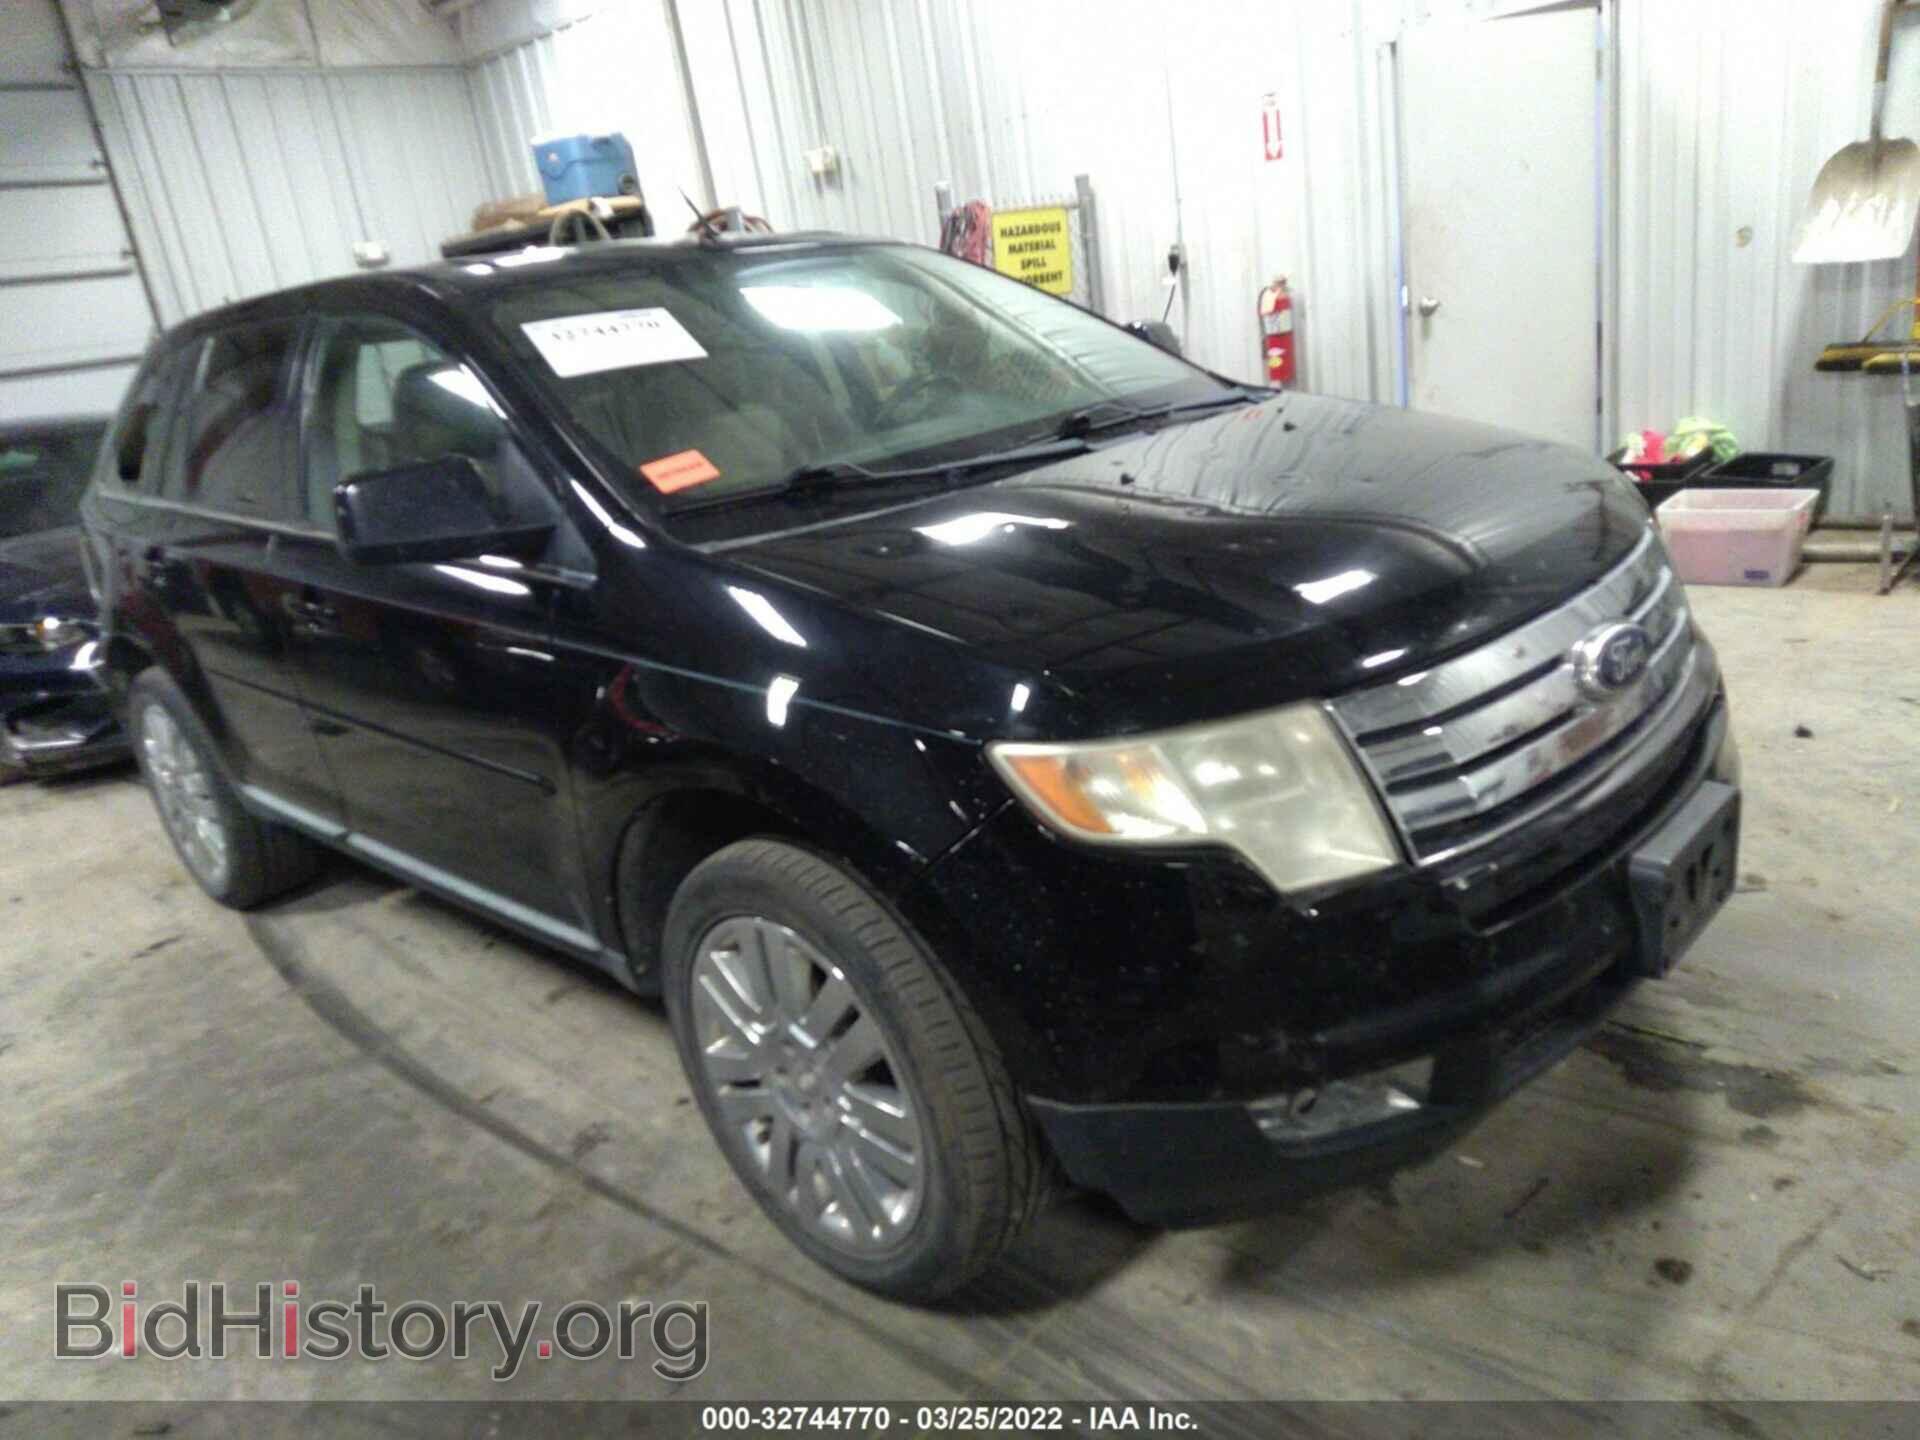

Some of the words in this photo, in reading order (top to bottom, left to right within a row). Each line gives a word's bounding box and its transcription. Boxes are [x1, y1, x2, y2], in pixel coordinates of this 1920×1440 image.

[1000, 221, 1062, 237] HAZARDOUS
[1008, 239, 1056, 254] MATERIAL
[1020, 255, 1047, 271] SPILL
[1019, 270, 1064, 285] ORBENT
